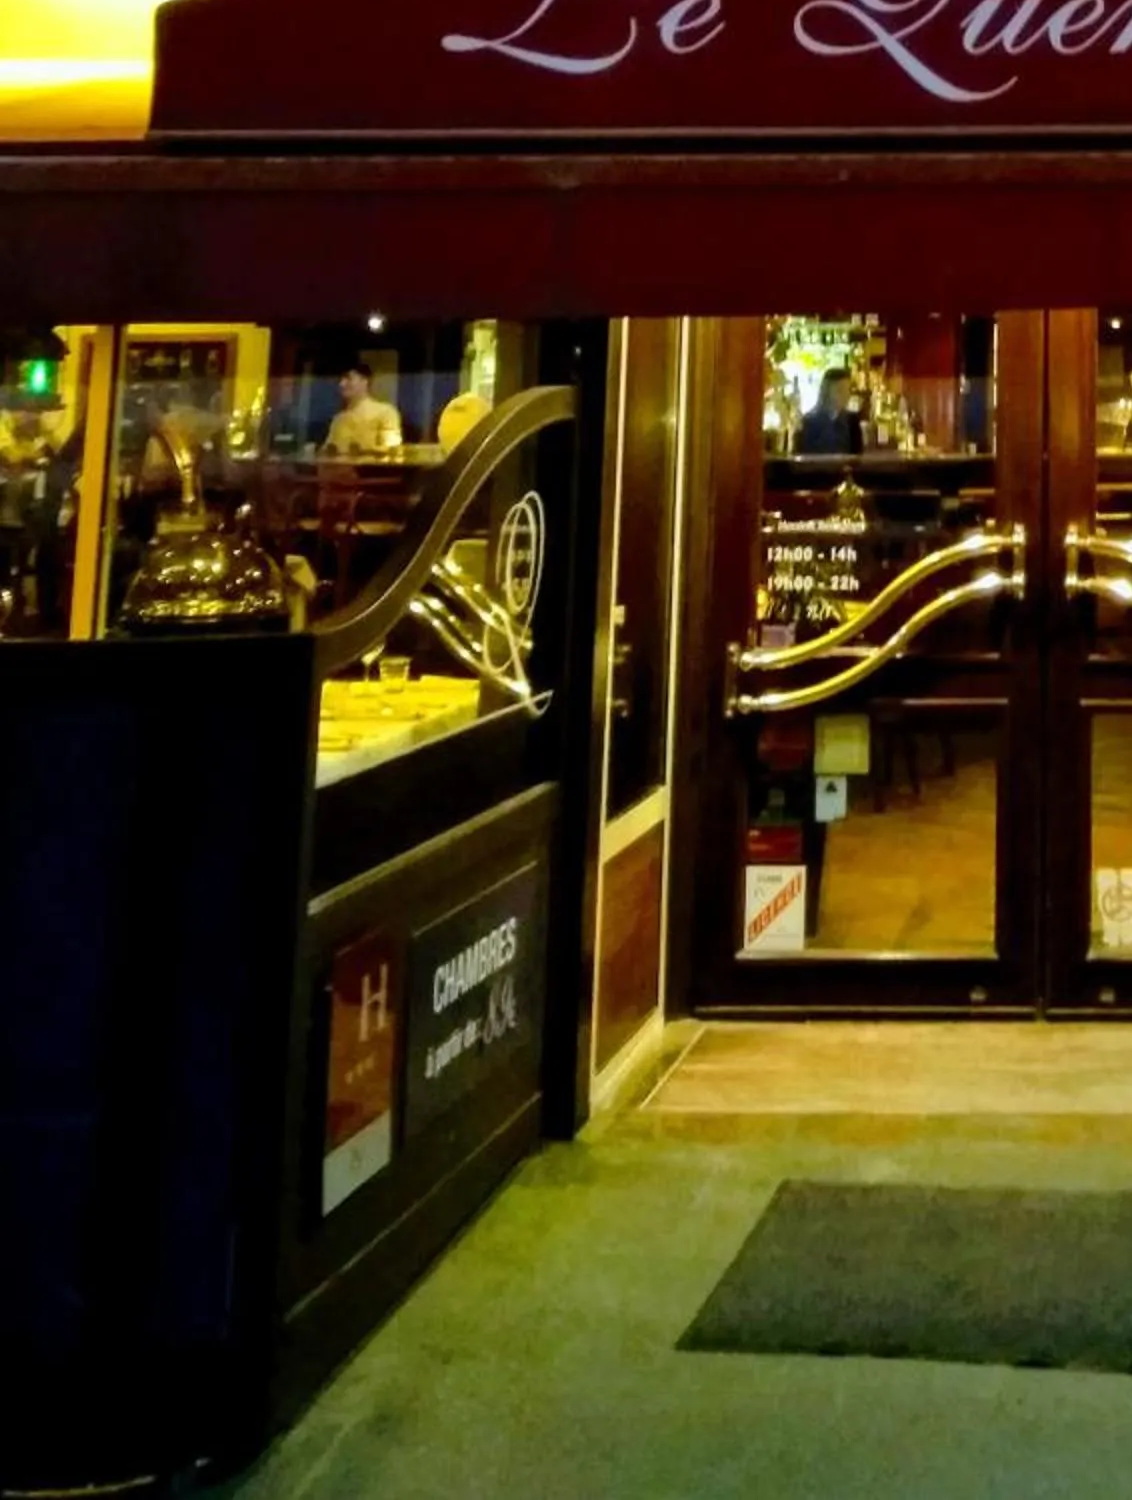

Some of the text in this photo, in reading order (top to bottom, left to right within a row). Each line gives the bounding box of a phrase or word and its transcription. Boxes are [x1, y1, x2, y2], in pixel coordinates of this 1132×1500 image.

[766, 545, 813, 562] 12h00
[830, 545, 857, 562] 14h
[829, 574, 859, 592] 22h
[433, 916, 517, 1014] CHAMBRES
[359, 962, 388, 1043] H
